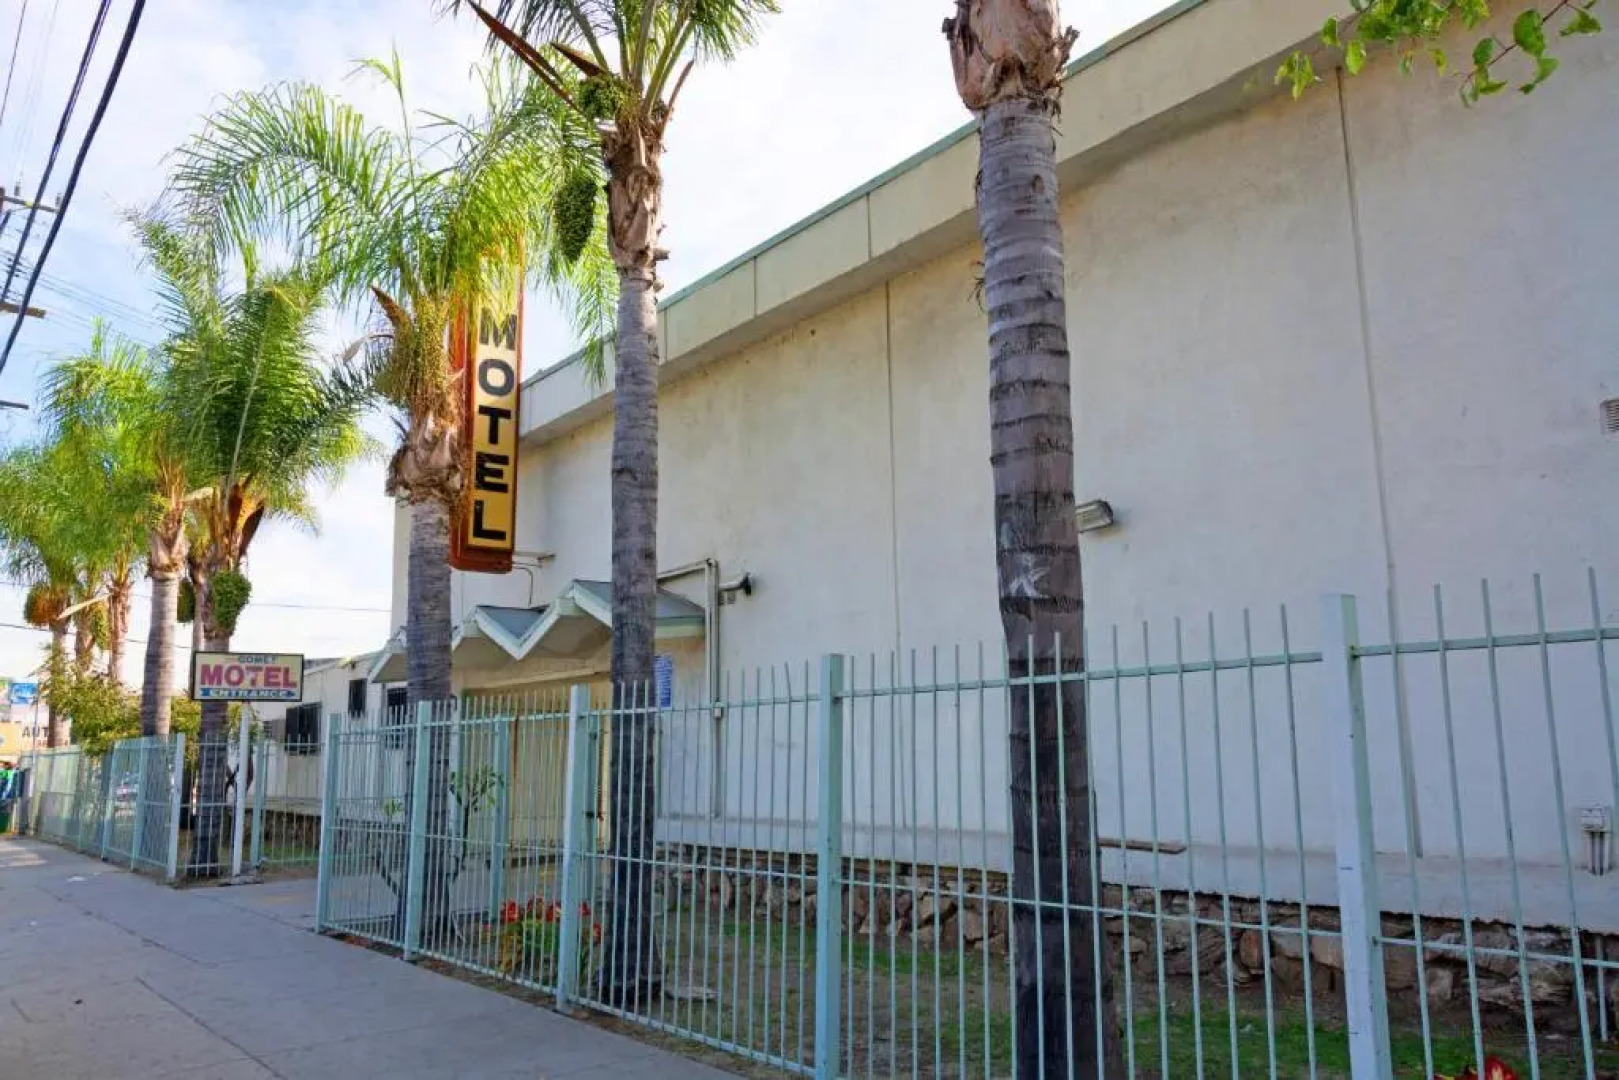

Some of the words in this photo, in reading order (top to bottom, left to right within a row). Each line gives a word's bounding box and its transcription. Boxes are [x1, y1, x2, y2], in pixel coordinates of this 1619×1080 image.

[473, 307, 518, 540] MOTEL
[200, 663, 298, 688] MOTEL
[210, 689, 286, 698] ENTRANCE
